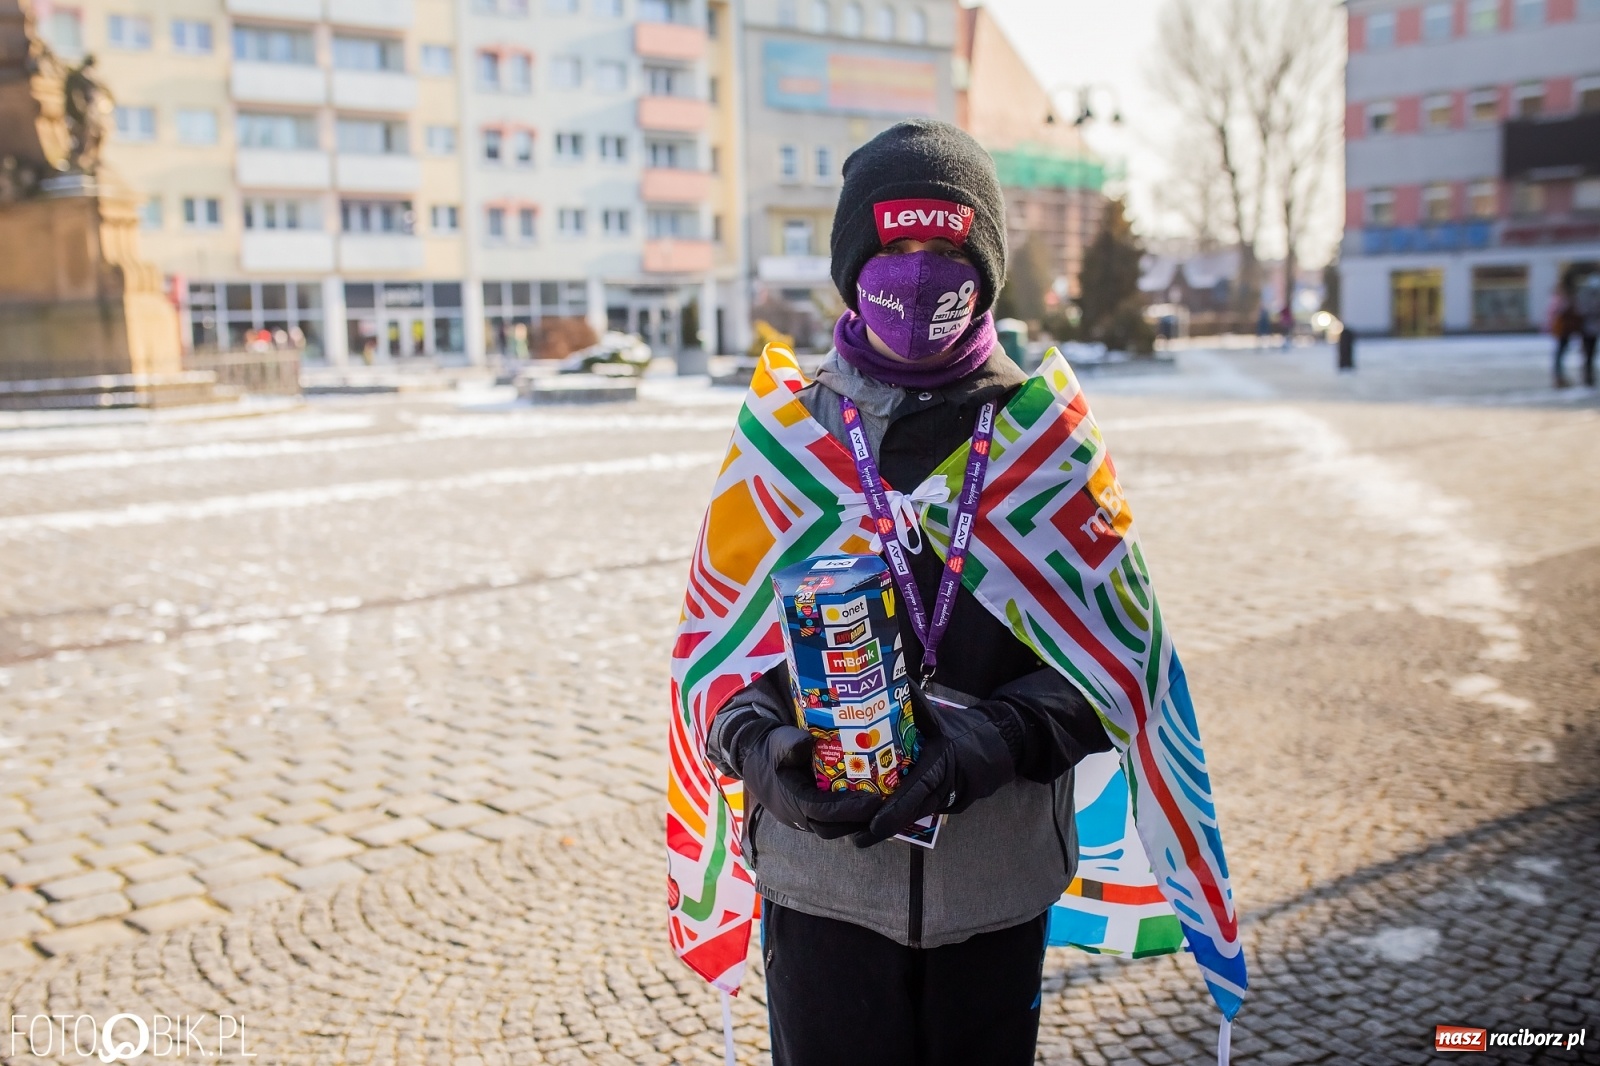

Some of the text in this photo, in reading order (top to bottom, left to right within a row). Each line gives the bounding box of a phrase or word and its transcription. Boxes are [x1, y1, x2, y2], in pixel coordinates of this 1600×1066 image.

[932, 280, 975, 322] 29
[981, 403, 991, 431] PLAY
[852, 431, 866, 459] PLAY
[957, 515, 969, 547] PLAY
[890, 544, 906, 573] PLAY
[842, 601, 865, 618] onet
[833, 649, 875, 668] mBank
[836, 674, 879, 694] PLAY
[838, 699, 886, 722] allegro
[880, 752, 893, 767] ups
